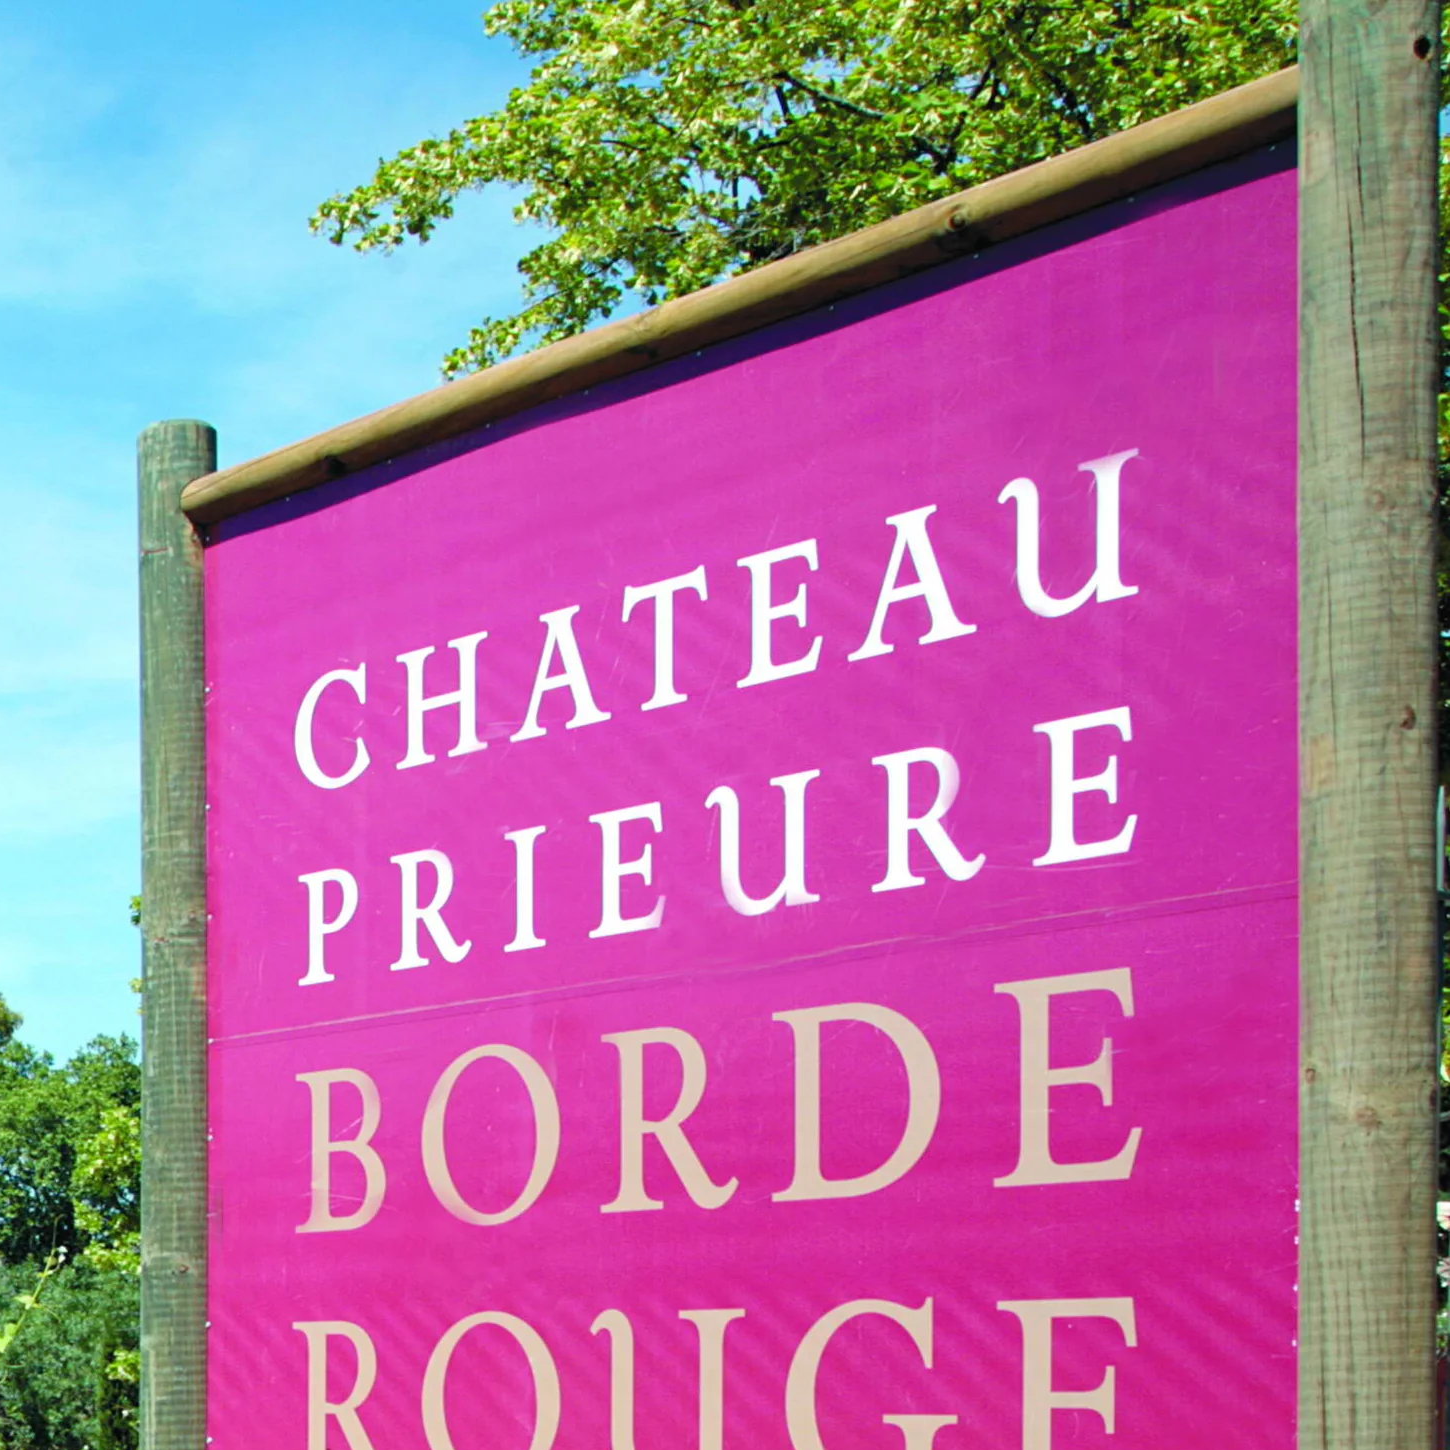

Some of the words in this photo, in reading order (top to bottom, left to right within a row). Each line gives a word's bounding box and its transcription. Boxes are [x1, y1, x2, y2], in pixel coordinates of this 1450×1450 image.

[294, 448, 1140, 790] CHATEAU
[297, 706, 1140, 987] PRIEURE
[295, 967, 1143, 1233] BORDE
